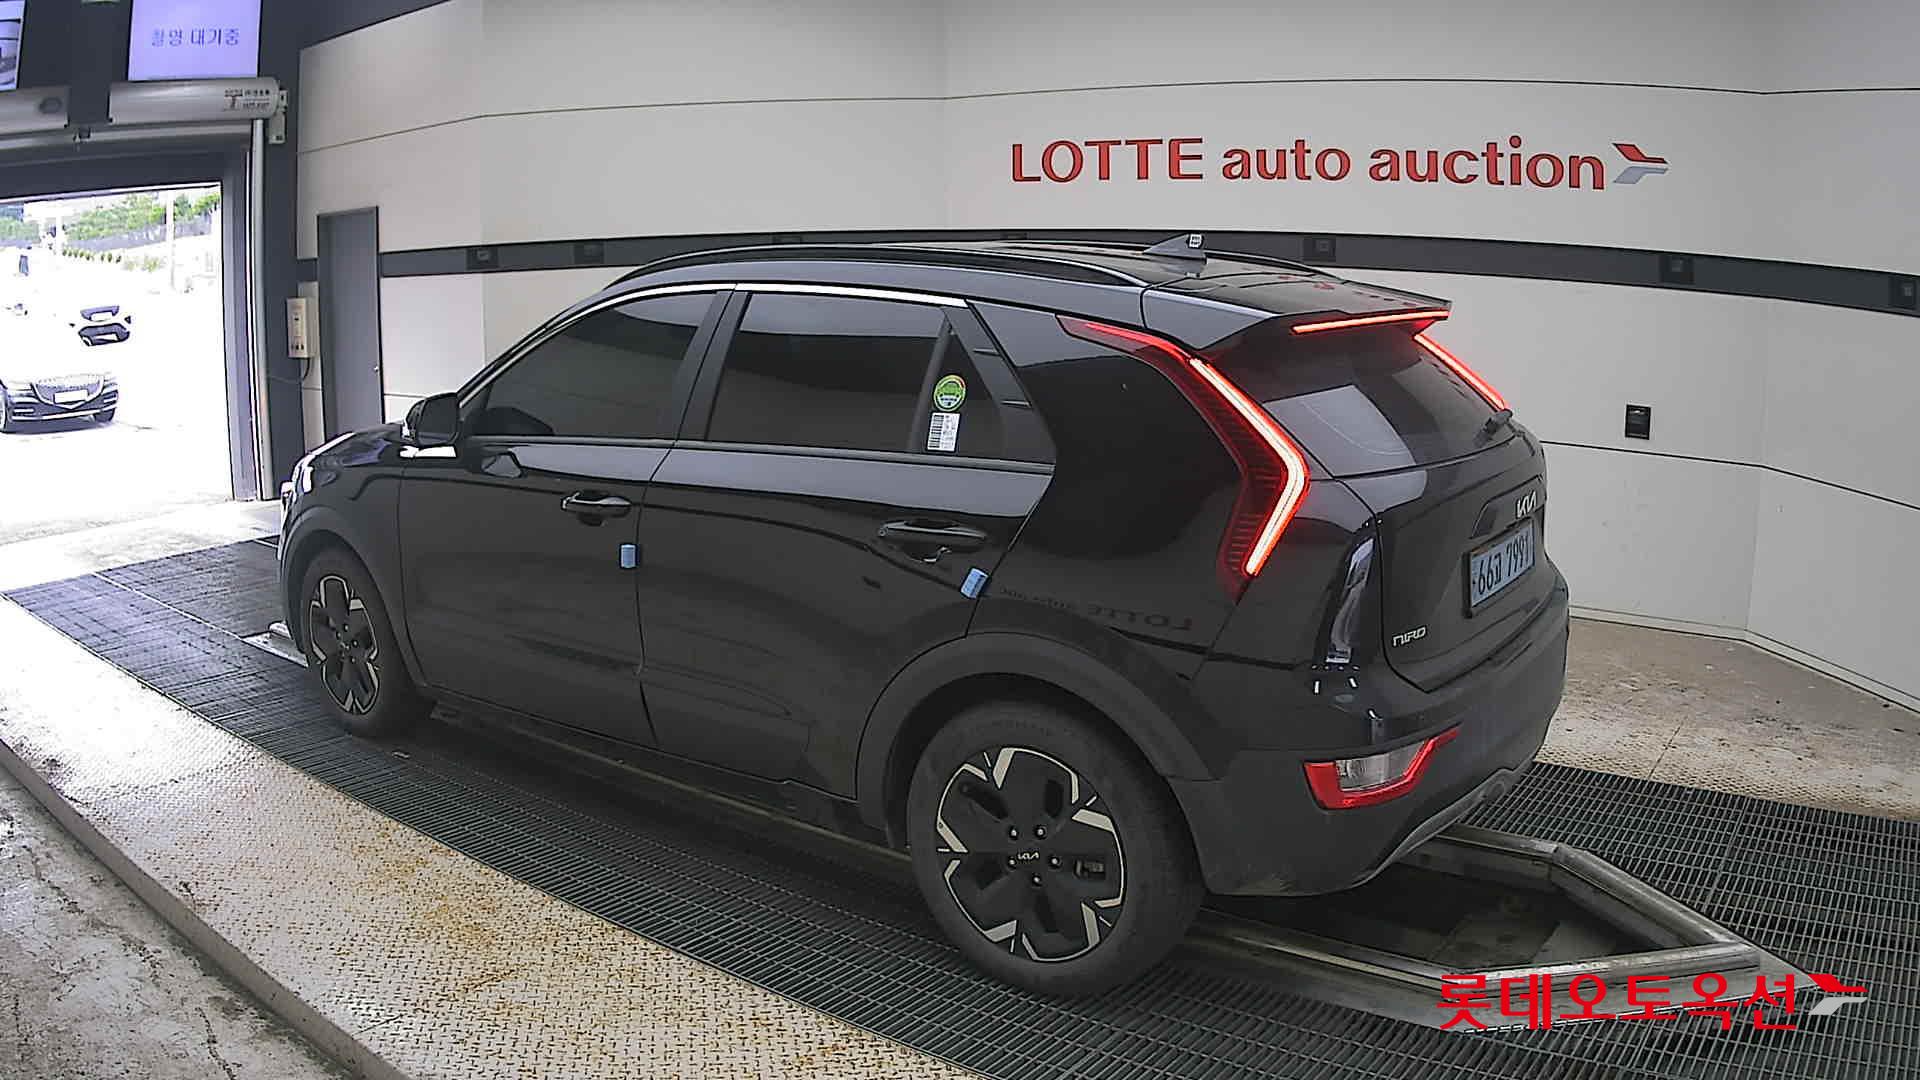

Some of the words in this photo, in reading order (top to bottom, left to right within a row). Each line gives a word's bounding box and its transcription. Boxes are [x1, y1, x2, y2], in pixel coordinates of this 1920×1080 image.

[191, 27, 239, 46] 대기중
[1011, 138, 1204, 183] LOTTE
[1221, 139, 1352, 182] auto
[1368, 136, 1606, 190] auction
[1516, 490, 1537, 518] KIA
[1392, 626, 1427, 647] NIRO
